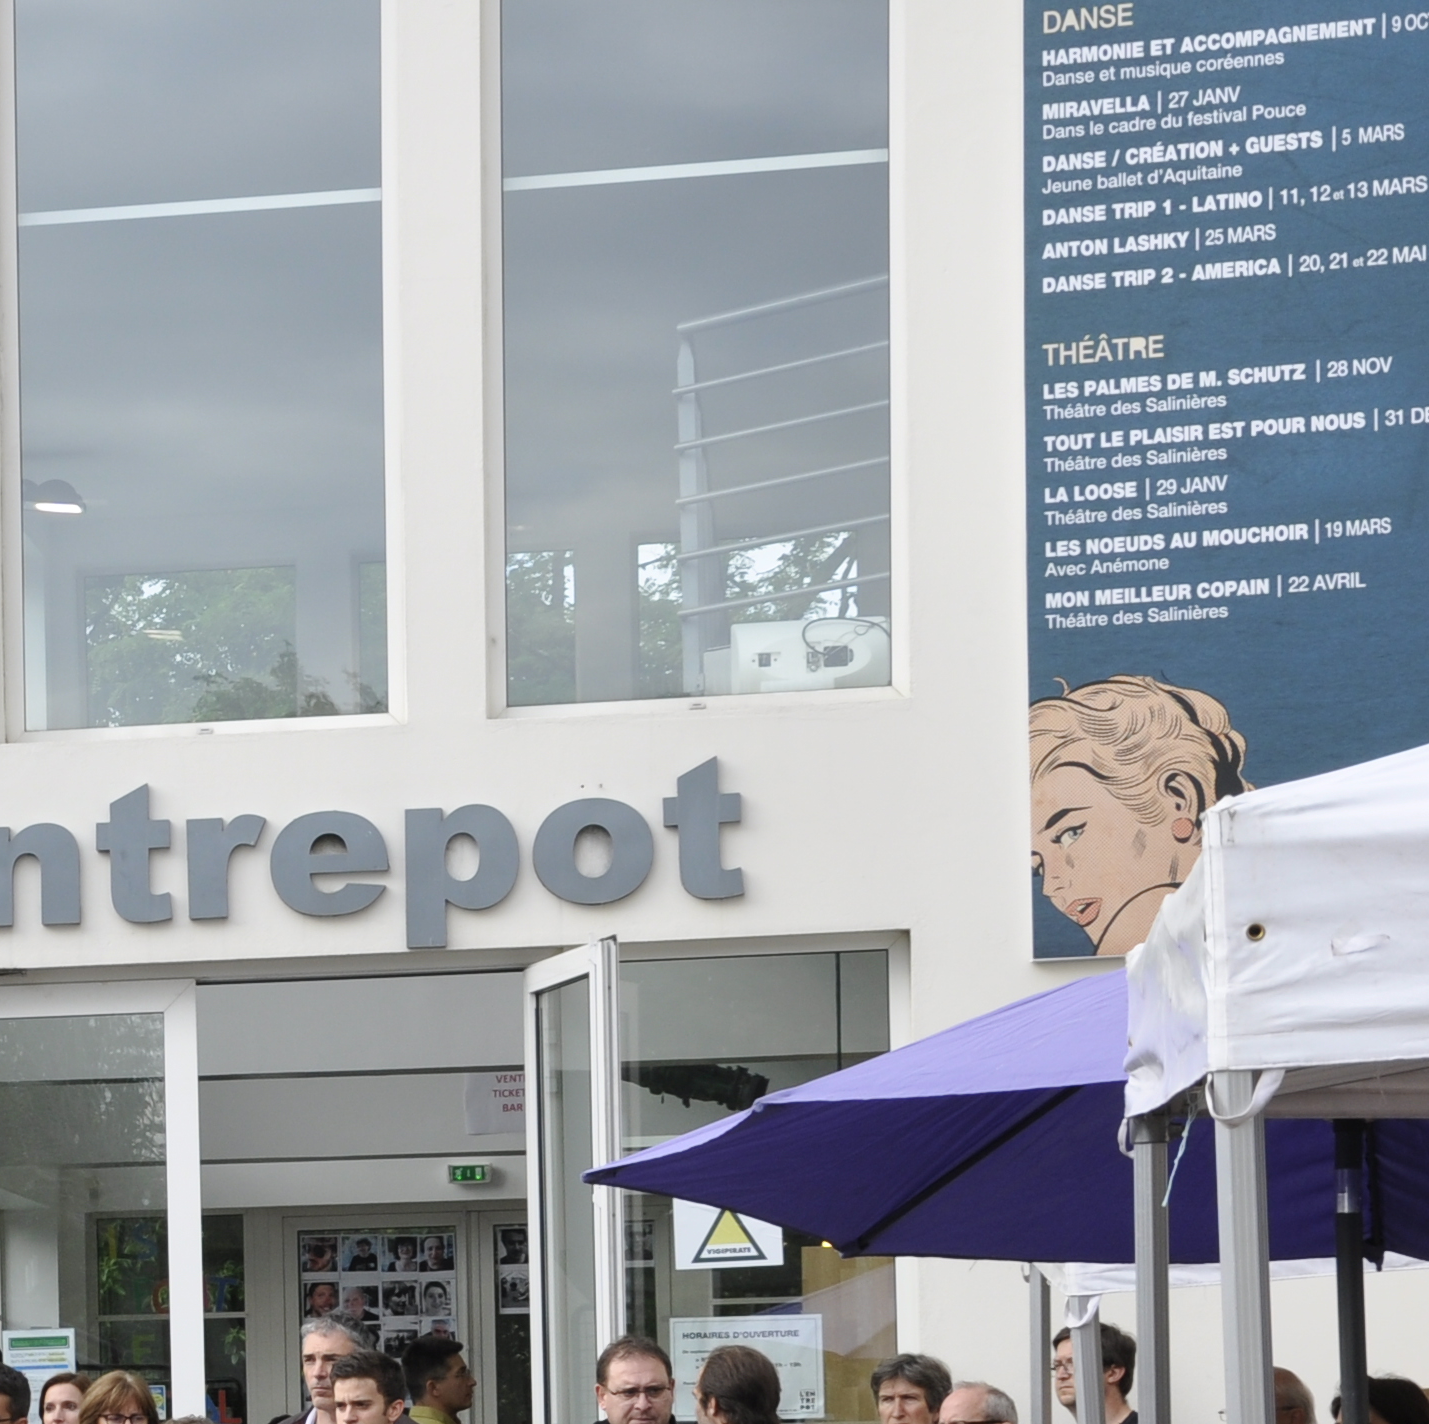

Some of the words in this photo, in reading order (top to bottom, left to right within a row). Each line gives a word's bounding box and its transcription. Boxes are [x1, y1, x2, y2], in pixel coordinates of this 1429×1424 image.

[1043, 2, 1134, 34] DANSE
[1042, 40, 1145, 67] HARMONIE
[1149, 37, 1176, 57] ET
[1179, 17, 1377, 54] ACCOMPAGNEMENT
[1391, 15, 1402, 33] 9
[1404, 12, 1429, 32] OC
[1042, 70, 1095, 87] Danse
[1098, 65, 1116, 82] et
[1120, 60, 1192, 80] musique
[1195, 51, 1285, 73] coréennes
[1042, 94, 1151, 121] MIRAVELLA
[1168, 90, 1190, 109] 27
[1192, 85, 1241, 107] JANV
[1042, 124, 1086, 140] Dans
[1089, 120, 1105, 136] le
[1108, 116, 1157, 134] cadre
[1159, 111, 1183, 129] du
[1186, 105, 1247, 127] festival
[1252, 103, 1307, 121] Pouce
[1042, 150, 1107, 173] DANSE
[1124, 139, 1224, 166] CRÉATION
[1244, 130, 1324, 155] GUESTS
[1341, 128, 1352, 146] 5
[1358, 122, 1405, 144] MARS
[1041, 178, 1093, 195] Jeune
[1096, 171, 1143, 190] ballet
[1146, 163, 1243, 186] d'Aquitaine
[1042, 204, 1107, 226] DANSE
[1111, 200, 1157, 220] TRIP
[1162, 198, 1172, 216] 1
[1191, 190, 1263, 213] LATINO
[1279, 187, 1306, 207] 11,
[1309, 184, 1331, 203] 12
[1332, 189, 1345, 201] et
[1346, 180, 1369, 199] 13
[1372, 175, 1429, 197] MARS
[1041, 238, 1109, 260] ANTON
[1113, 230, 1190, 254] LASHKY
[1204, 228, 1225, 246] 25
[1227, 223, 1277, 244] MARS
[1042, 272, 1107, 294] DANSE
[1111, 268, 1157, 288] TRIP
[1160, 267, 1174, 284] 2
[1191, 257, 1282, 282] AMERICA
[1298, 254, 1325, 273] 20,
[1328, 252, 1348, 270] 21
[1352, 256, 1365, 268] et
[1366, 248, 1389, 267] 22
[1392, 244, 1427, 264] MAI
[1041, 333, 1165, 367] THÉÂTRE
[1042, 381, 1080, 400] LES
[1083, 374, 1163, 397] PALMES
[1166, 372, 1194, 391] DE
[1198, 370, 1223, 388] M.
[1227, 363, 1307, 386] SCHUTZ
[1326, 359, 1349, 378] 28
[1352, 355, 1393, 376] NOV
[1042, 402, 1107, 421] Théâtre
[1110, 400, 1142, 416] des
[1145, 393, 1228, 413] Salinières
[1043, 432, 1096, 453] TOUT
[1100, 430, 1125, 449] LE
[1129, 424, 1204, 446] PLAISIR
[1208, 420, 1246, 440] EST
[1250, 416, 1306, 437] POUR
[1310, 411, 1367, 433] NOUS
[1384, 408, 1404, 427] 31
[1043, 455, 1107, 473] Théâtre
[1110, 452, 1142, 468] des
[1146, 446, 1228, 466] Salinières
[1044, 486, 1069, 504] LA
[1073, 481, 1138, 502] LOOSE
[1156, 478, 1178, 496] 29
[1180, 474, 1229, 495] JANV
[1043, 508, 1108, 526] Théâtre
[1111, 505, 1143, 522] des
[1146, 500, 1228, 519] Salinières
[1045, 539, 1082, 558] LES
[1085, 533, 1166, 555] NOEUDS
[1169, 531, 1197, 550] AU
[1202, 523, 1309, 547] MOUCHOIR
[1324, 520, 1343, 538] 19
[1345, 517, 1392, 537] MARS
[1044, 562, 1087, 578] Avec
[1090, 557, 1170, 575] Anémone
[1045, 590, 1090, 609] MON
[1094, 583, 1192, 606] MEILLEUR
[1196, 577, 1270, 599] COPAIN
[1288, 575, 1310, 593] 22
[1312, 571, 1367, 592] AVRIL
[1044, 612, 1109, 630] Théâtre
[1112, 610, 1144, 626] des
[1147, 604, 1229, 623] Salinières
[502, 1103, 523, 1113] BAR
[706, 1246, 752, 1255] VIGIPIRATE
[682, 1331, 730, 1340] HORAIRES
[733, 1329, 800, 1339] D'OUVERTURE
